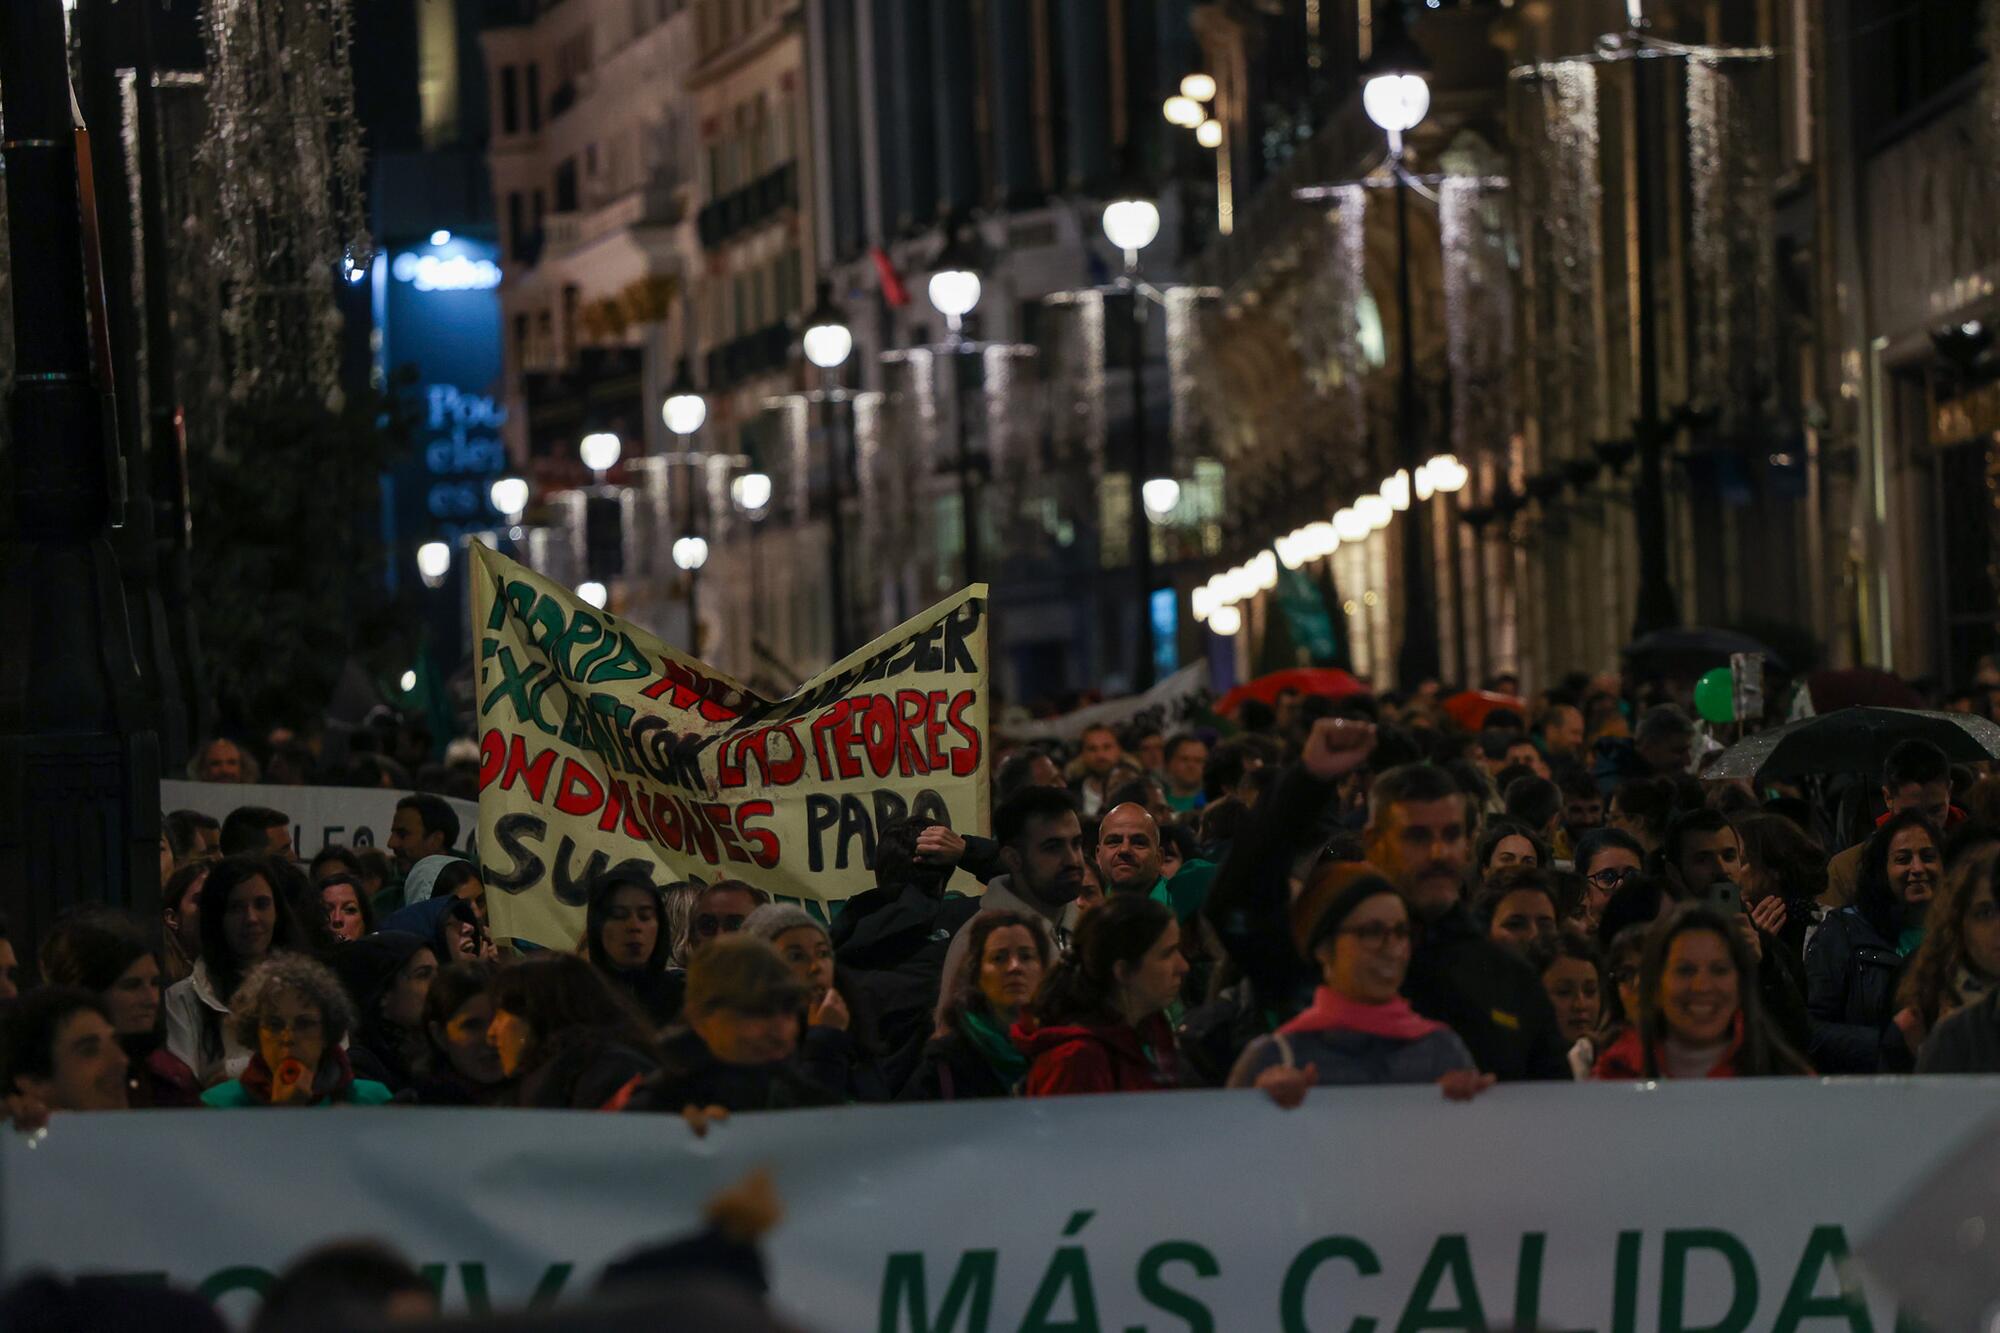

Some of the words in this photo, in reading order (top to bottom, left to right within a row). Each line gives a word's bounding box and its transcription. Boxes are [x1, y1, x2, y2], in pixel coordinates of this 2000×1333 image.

[811, 688, 982, 782] PEORES
[479, 728, 780, 870] ONDICIONES
[482, 813, 655, 907] SU
[878, 1210, 1221, 1333] MÁS
[1280, 1225, 1922, 1333] CALIDA
